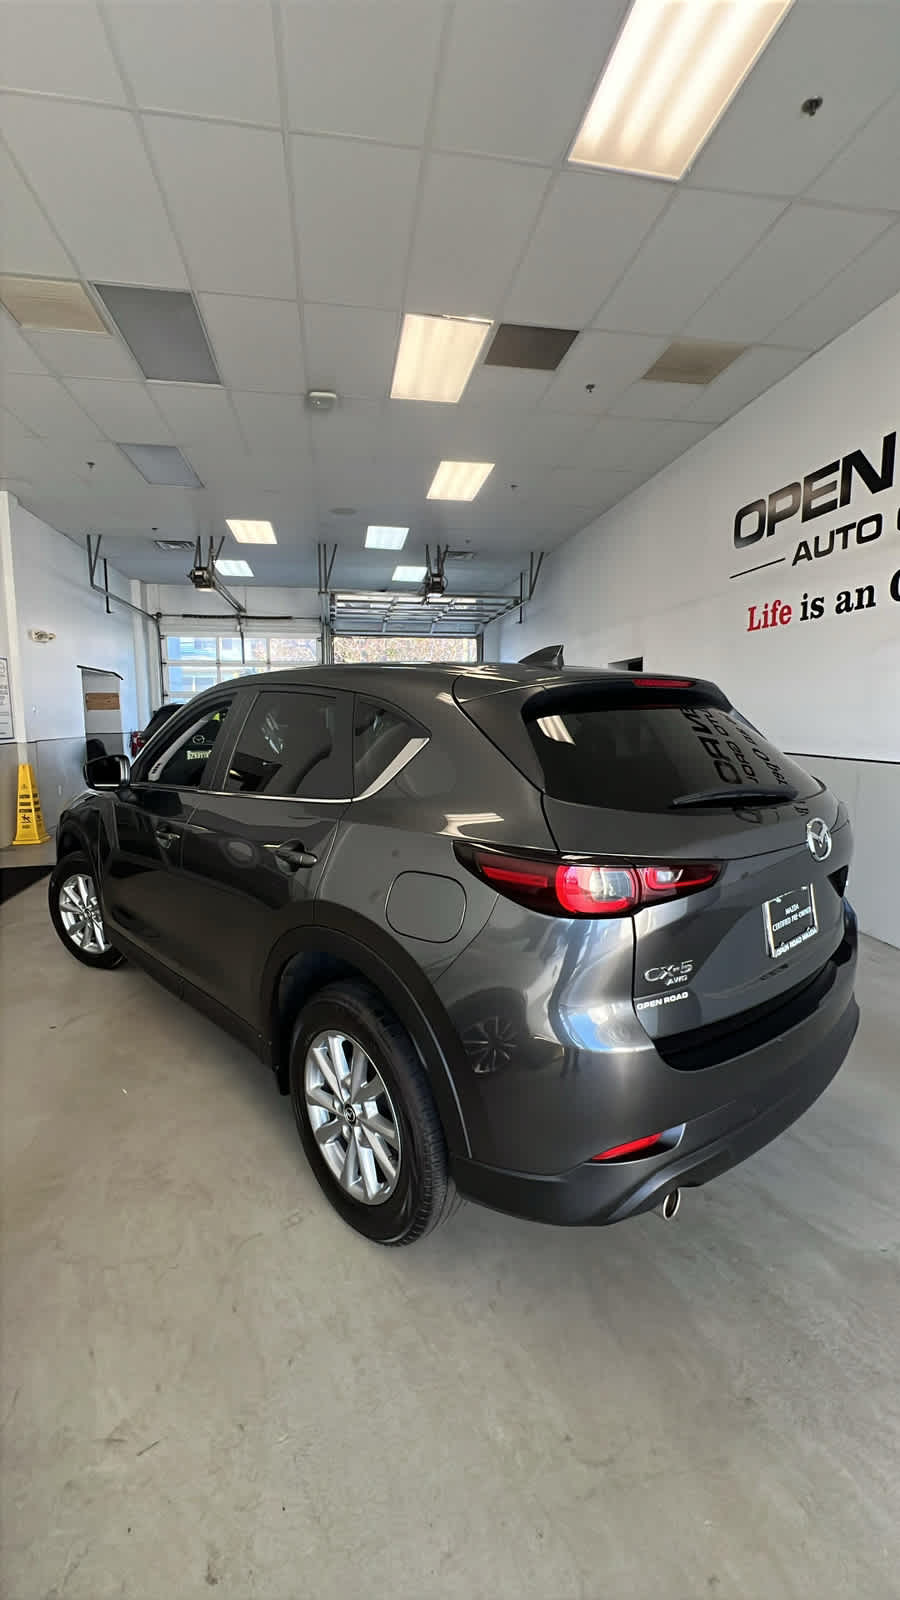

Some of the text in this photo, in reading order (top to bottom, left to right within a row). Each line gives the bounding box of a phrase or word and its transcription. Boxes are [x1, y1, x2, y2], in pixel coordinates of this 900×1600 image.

[734, 431, 896, 549] OPEN
[792, 513, 883, 566] AUTO
[747, 600, 792, 632] Life
[800, 593, 825, 621] is
[835, 584, 876, 614] an
[644, 960, 694, 981] CX-5
[665, 974, 688, 986] AWD
[636, 991, 689, 1010] OPEN ROAD
